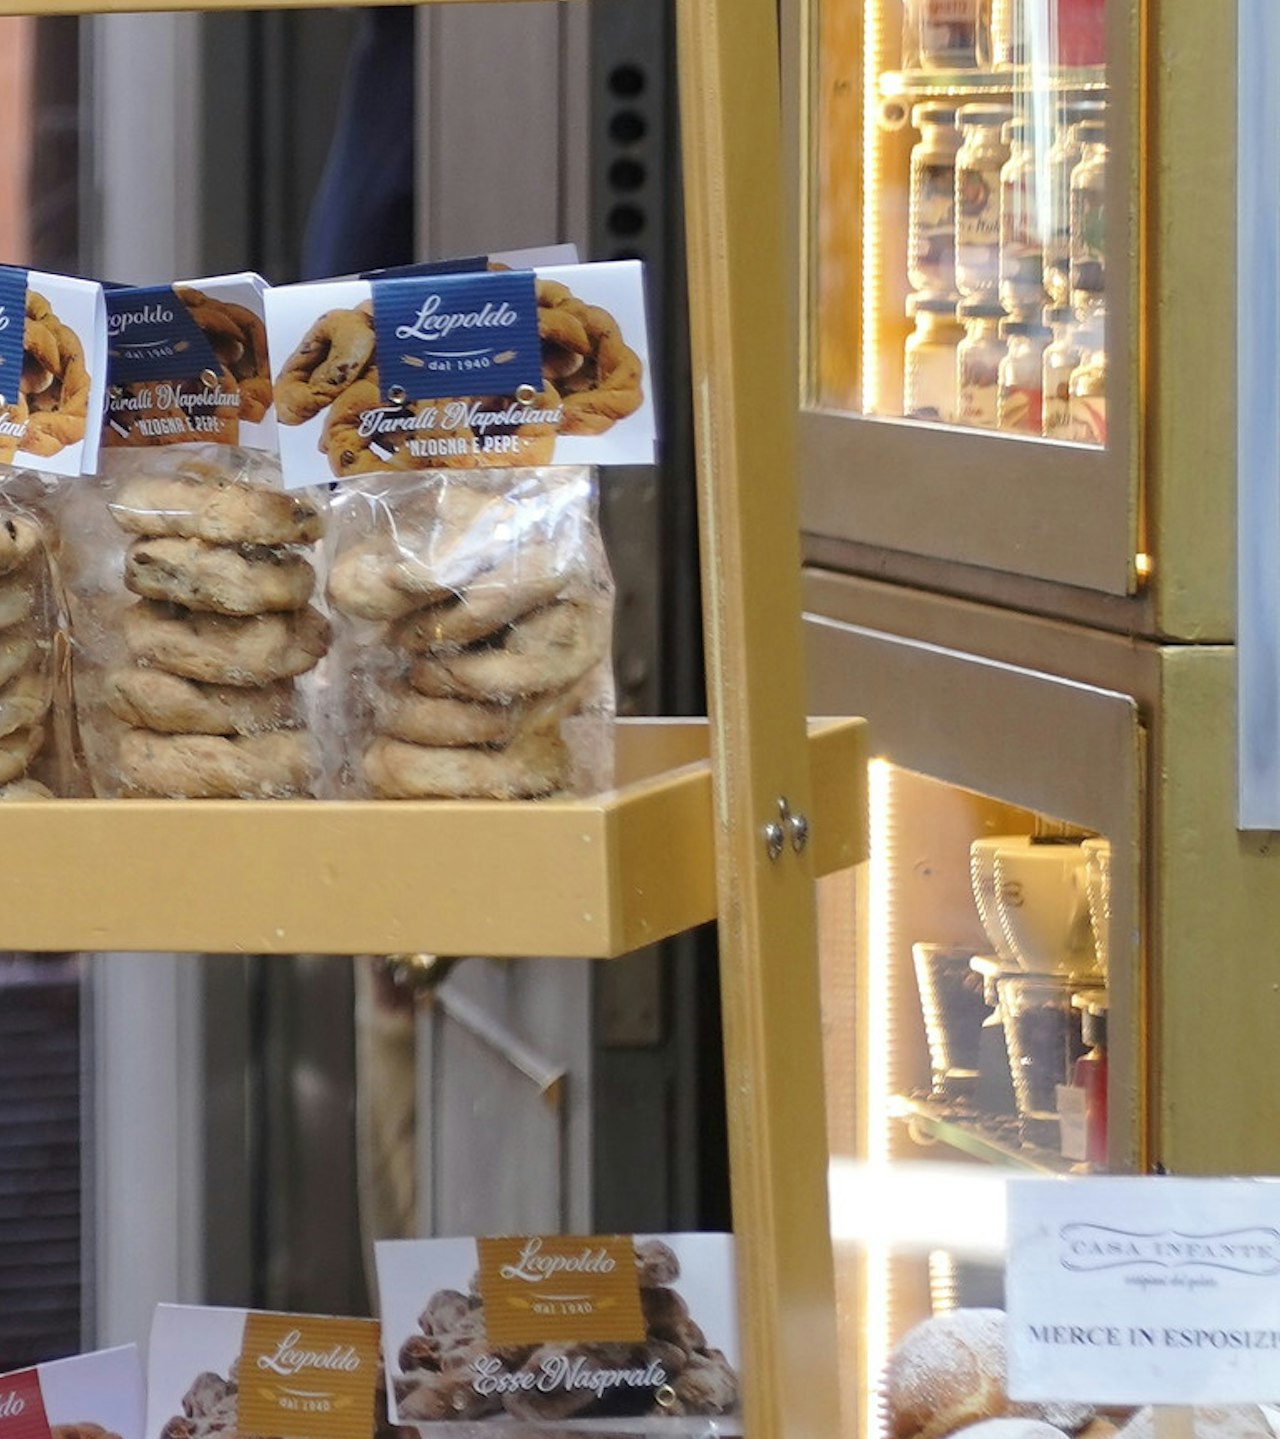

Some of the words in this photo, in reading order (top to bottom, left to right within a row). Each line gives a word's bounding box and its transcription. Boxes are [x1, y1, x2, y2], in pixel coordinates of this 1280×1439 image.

[396, 295, 518, 340] Leopoldo
[428, 360, 451, 372] dal
[457, 357, 490, 371] 1940
[358, 406, 435, 438] Taralli
[440, 402, 564, 438] Napoletani
[473, 438, 483, 455] E
[483, 436, 520, 455] PEPE
[501, 1238, 616, 1281] Leopoldo
[1069, 1240, 1141, 1258] CASA
[1153, 1240, 1275, 1259] INFANTE
[561, 1303, 592, 1315] 1940
[1028, 1324, 1121, 1346] MERCE
[1129, 1326, 1155, 1348] IN
[1163, 1326, 1280, 1350] ESPOSIZI
[257, 1331, 361, 1376] Leopoldo
[470, 1356, 537, 1397] Esse
